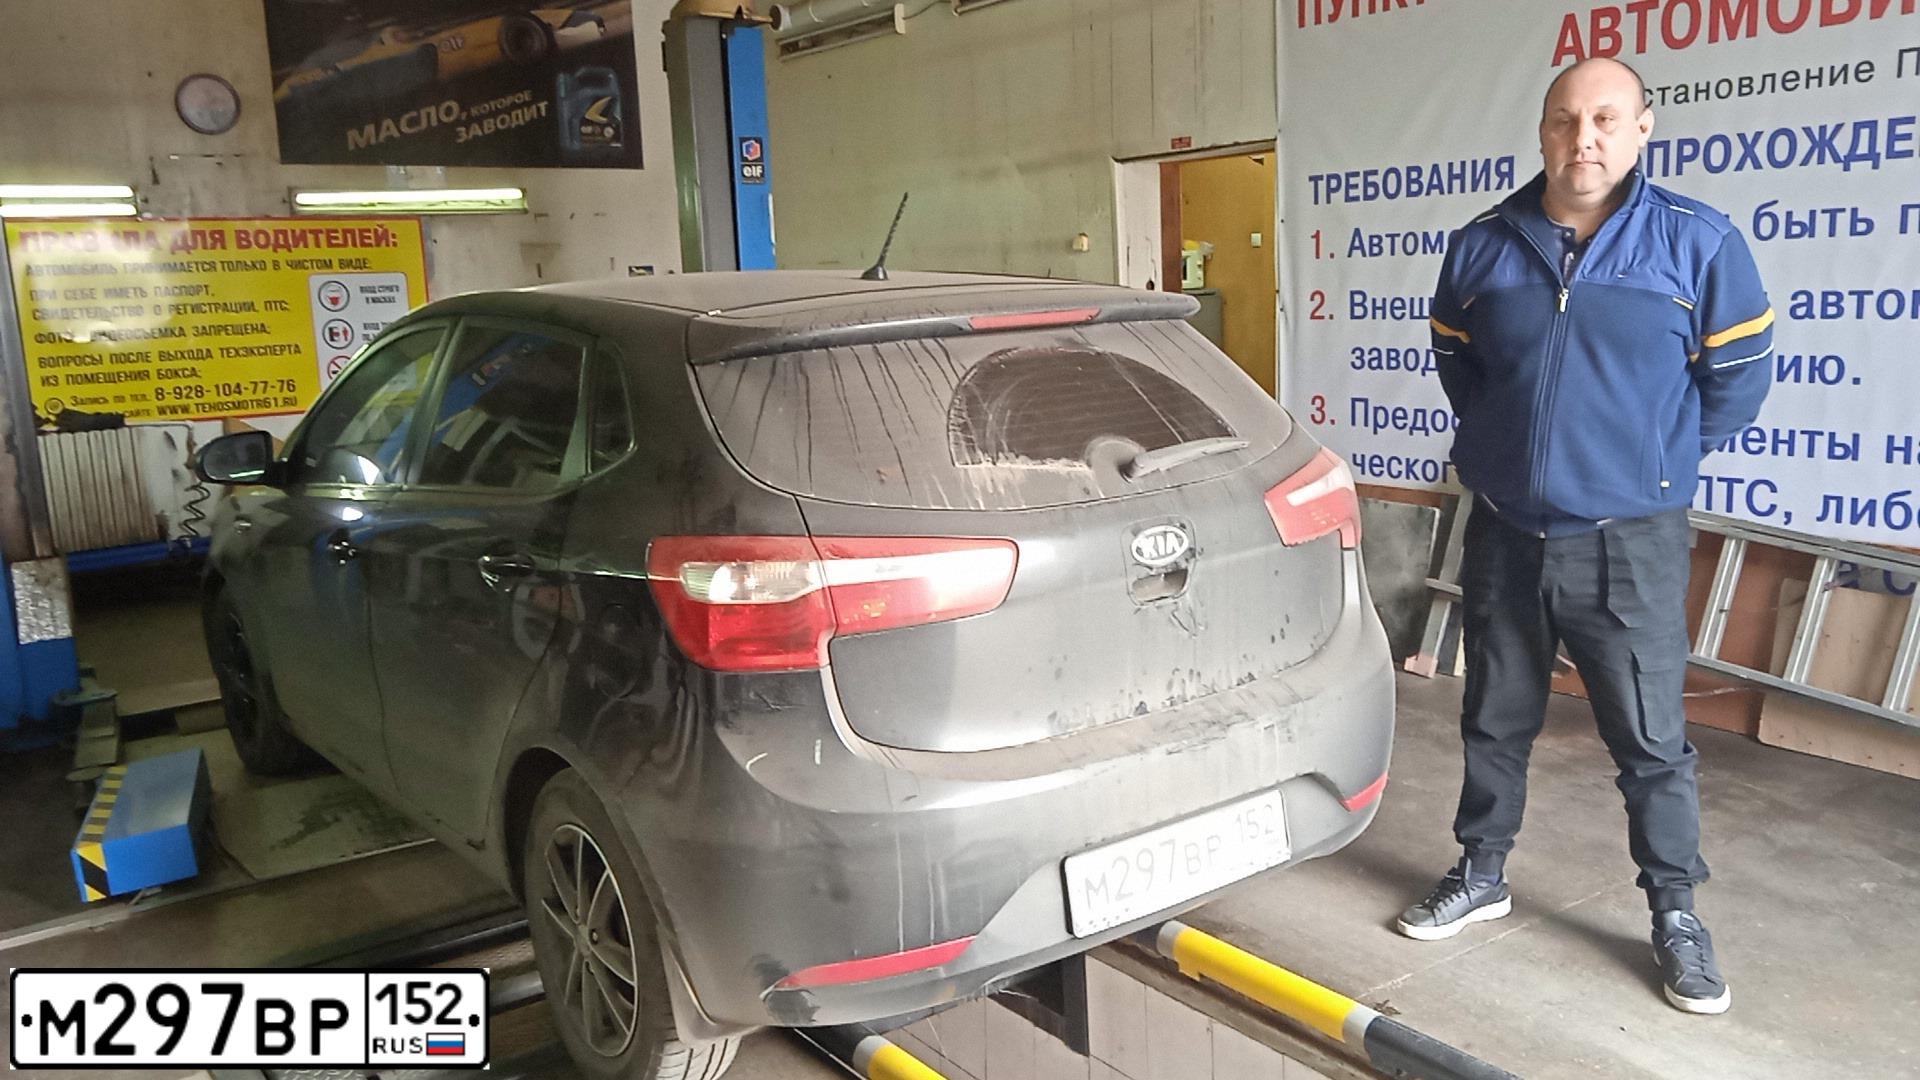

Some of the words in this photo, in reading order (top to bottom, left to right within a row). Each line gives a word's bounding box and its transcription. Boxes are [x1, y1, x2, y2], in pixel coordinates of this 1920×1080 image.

[346, 99, 468, 151] МАСЛО,
[454, 100, 549, 144] ЗАВОДИТ
[742, 165, 763, 177] elf
[1308, 156, 1515, 206] ТРЕБОВАНИЯ
[1646, 115, 1920, 179] ПРОХОЖДЕ
[170, 228, 228, 254] ДЛЯ
[235, 224, 399, 252] ВОДИТЕЛЕЙ:
[1310, 229, 1335, 260] 1.
[1347, 227, 1462, 258] Автом
[1752, 200, 1875, 241] быть
[220, 259, 267, 272] ТОЛЬКО
[272, 258, 281, 271] В
[286, 258, 334, 271] ЧИСТОМ
[1309, 289, 1335, 321] 2.
[38, 353, 103, 369] ВОПРОСЫ
[109, 351, 152, 365] ПОСЛЕ
[158, 347, 214, 362] ВЫХОДА
[41, 375, 59, 387] ИЗ
[66, 369, 150, 385] ПОМЕЩЕНИЯ
[1310, 394, 1336, 425] 3.
[1816, 489, 1920, 532] либ
